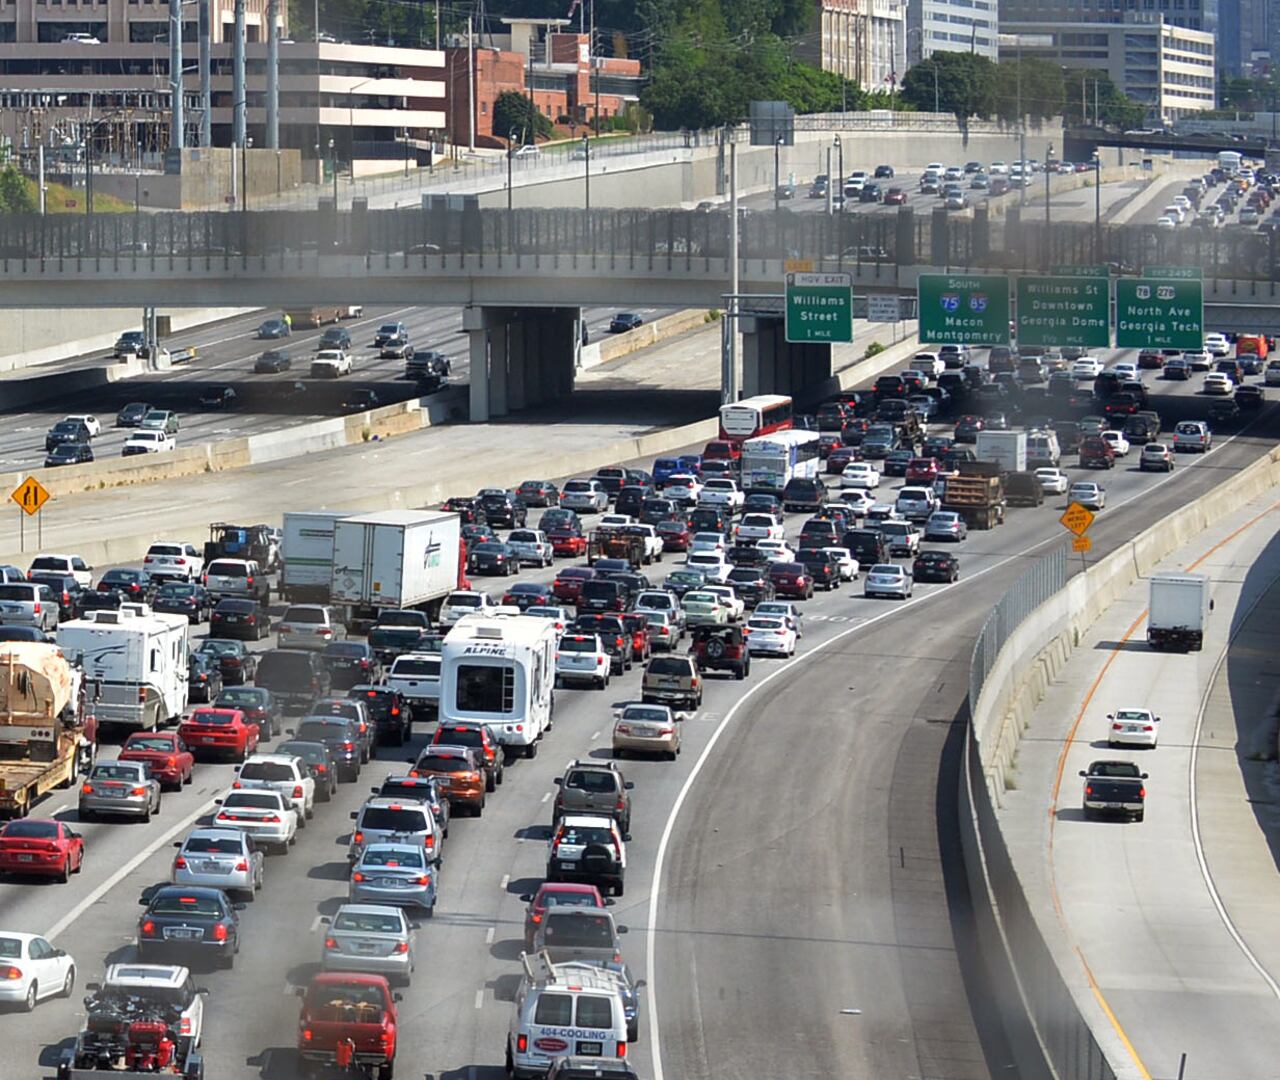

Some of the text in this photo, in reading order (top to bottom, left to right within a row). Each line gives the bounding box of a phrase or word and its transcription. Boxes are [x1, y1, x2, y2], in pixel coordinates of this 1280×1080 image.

[801, 276, 820, 284] HOV
[949, 279, 980, 289] SOUTH
[1027, 284, 1099, 294] Williams St
[793, 295, 845, 305] Williams
[942, 296, 959, 308] 75
[1032, 301, 1093, 310] Downtown
[800, 311, 838, 321] Street
[1127, 306, 1191, 316] North Ave
[945, 316, 984, 326] Macon
[1020, 316, 1105, 328] Georgia Dome
[1119, 321, 1200, 334] Georgia Tech
[927, 330, 1003, 342] Montgomery
[463, 646, 507, 656] ALPINE
[540, 1027, 607, 1040] 404-COOLING
